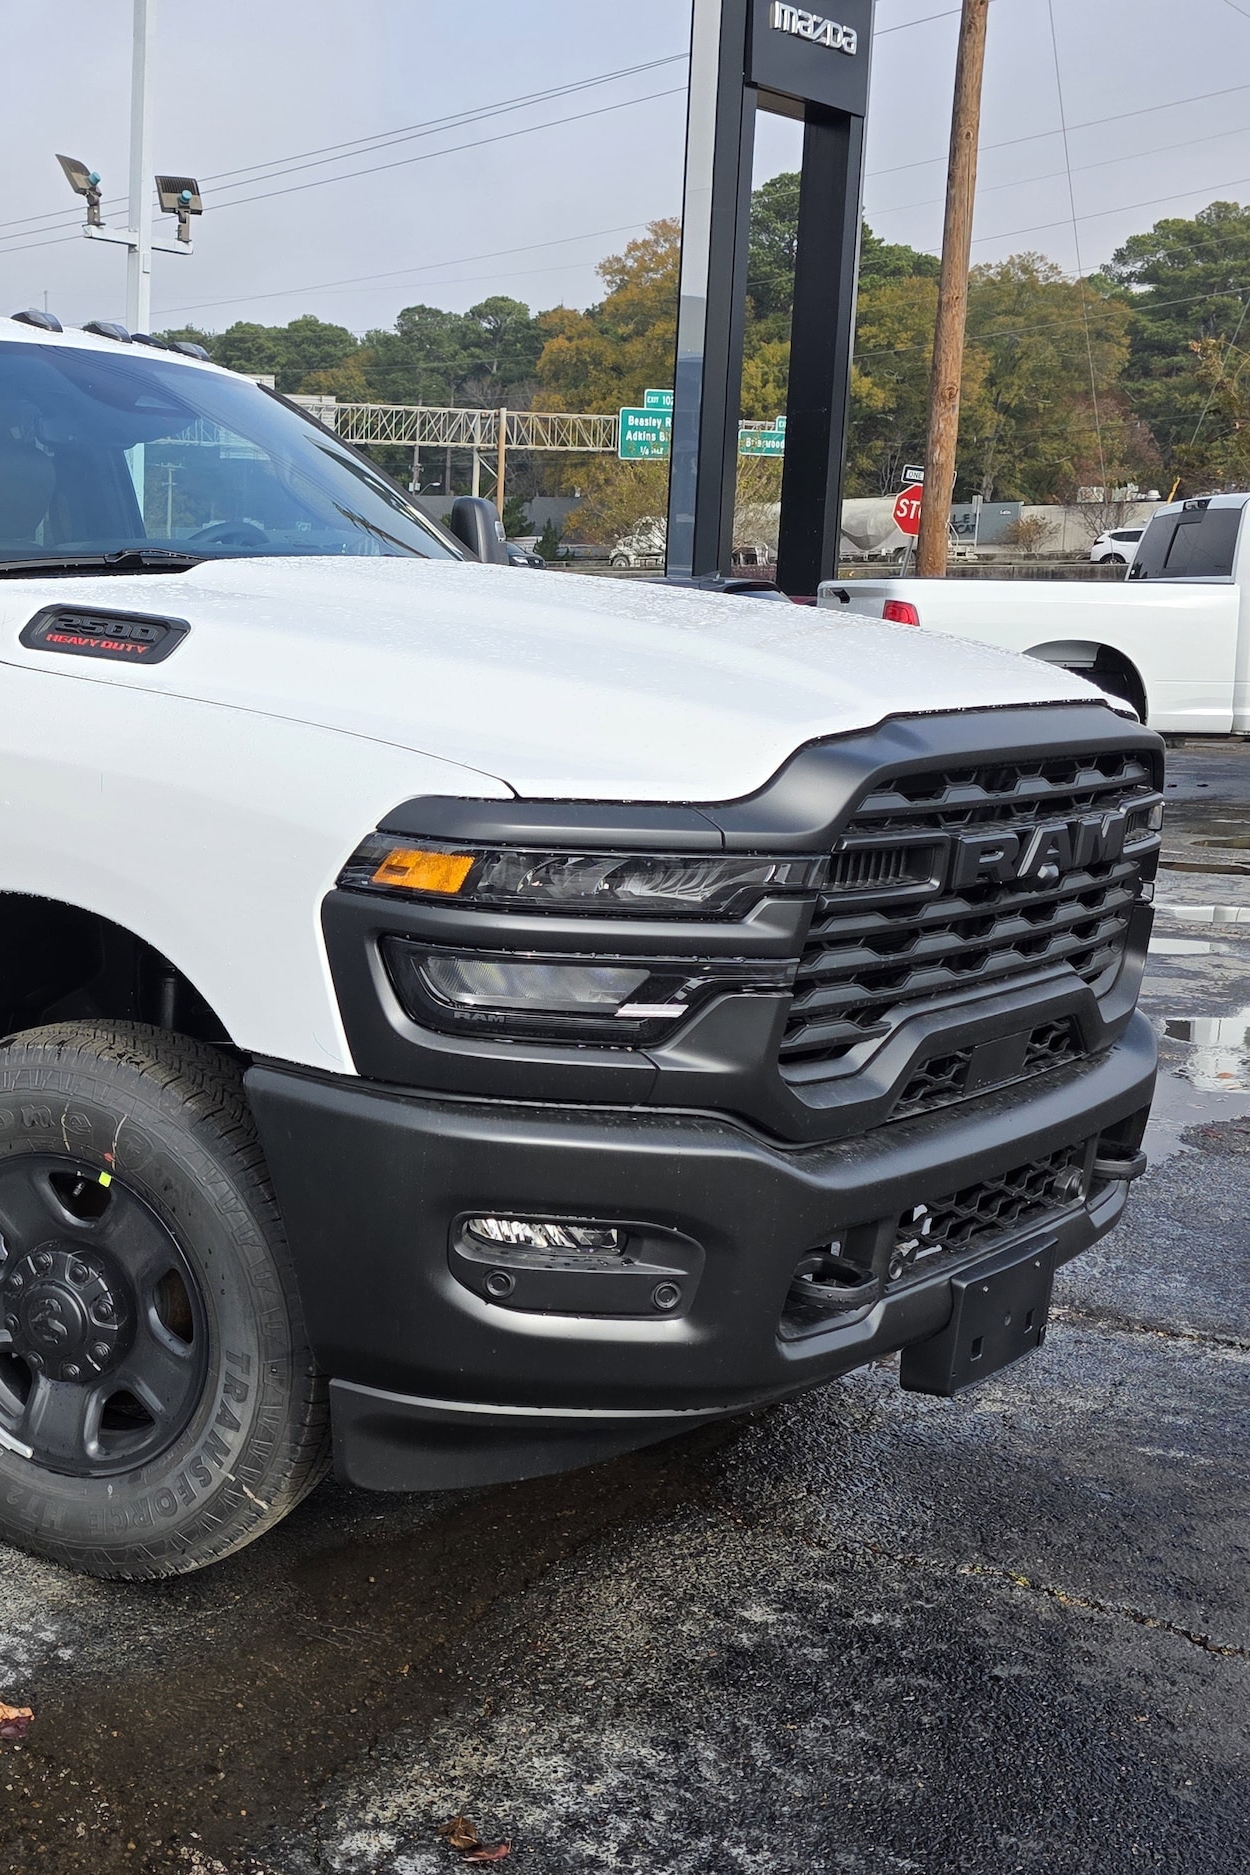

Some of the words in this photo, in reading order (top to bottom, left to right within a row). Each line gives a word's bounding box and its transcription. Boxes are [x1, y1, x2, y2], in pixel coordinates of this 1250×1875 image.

[769, 0, 858, 55] mazda
[647, 395, 659, 404] EXIT
[628, 414, 662, 430] Beasley
[625, 430, 657, 442] Adkins
[745, 437, 785, 449] Bawood
[908, 471, 923, 480] ONE
[896, 498, 922, 520] ST
[54, 613, 159, 643] 2500
[45, 633, 100, 648] HEAVY
[100, 640, 150, 655] DUTY
[952, 810, 1127, 889] RAM
[453, 1011, 506, 1024] RAM
[88, 1350, 250, 1537] TRANSFORCE
